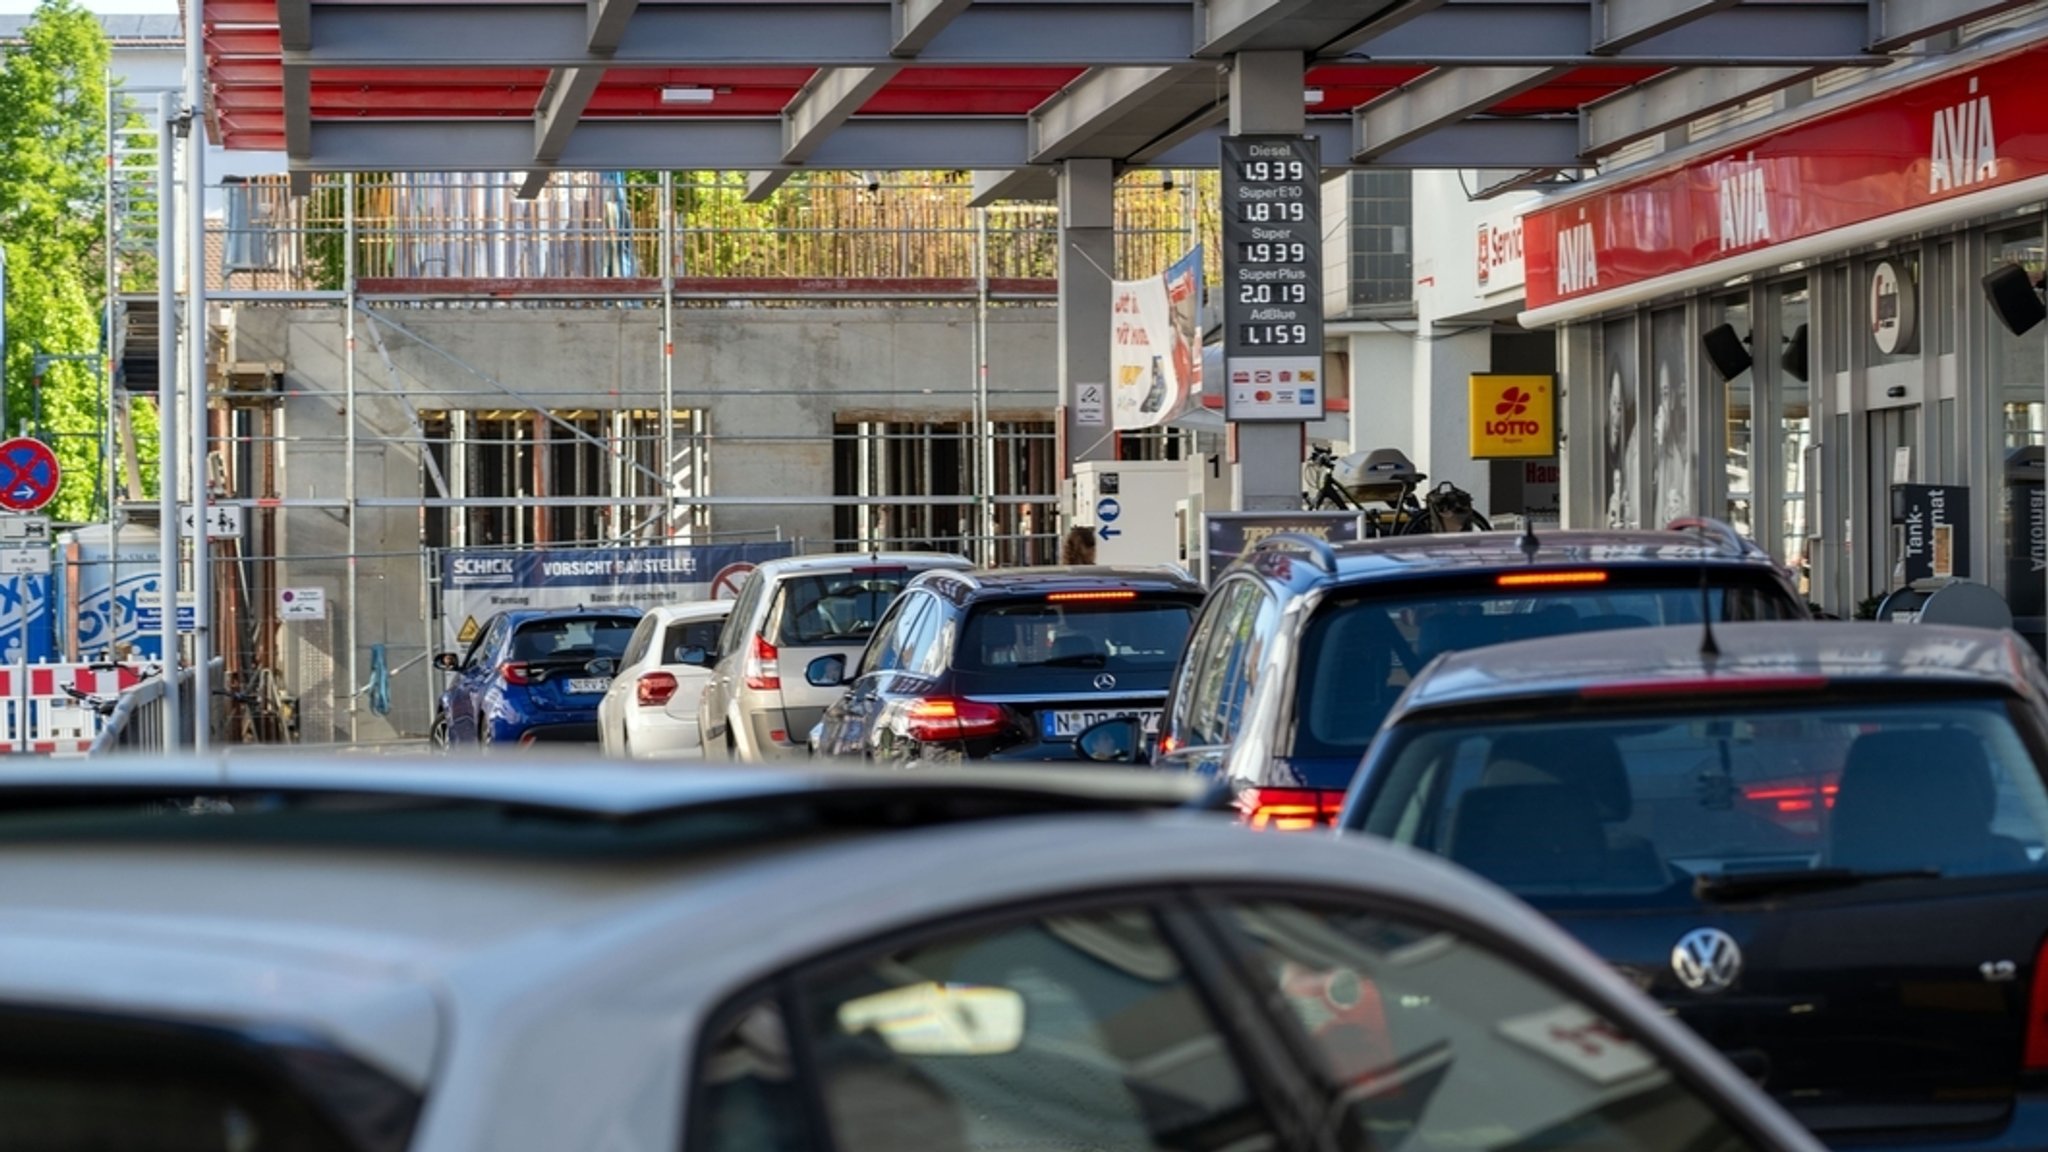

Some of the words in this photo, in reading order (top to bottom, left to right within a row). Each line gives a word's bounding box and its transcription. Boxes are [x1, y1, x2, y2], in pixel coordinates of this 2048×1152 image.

[1929, 76, 1998, 194] AVIA
[1249, 145, 1291, 157] Diesel
[1246, 161, 1303, 181] 1.939
[1239, 187, 1278, 199] Super
[1279, 186, 1303, 198] E10
[1720, 153, 1771, 251] AVIA
[1247, 202, 1304, 222] 1.879
[1252, 228, 1292, 240] Super
[1248, 243, 1304, 263] 1.939
[1557, 207, 1599, 296] AVIA
[1239, 269, 1277, 281] Super
[1278, 268, 1306, 280] Plus
[1240, 284, 1306, 304] 2.019
[1250, 308, 1297, 320] AdBlue
[1249, 325, 1306, 344] 1.159
[1485, 420, 1539, 436] LOTTO
[1208, 454, 1219, 478] 1
[1906, 504, 1923, 558] Tank-
[453, 558, 514, 575] SCHICK
[542, 559, 612, 577] VORSICHT
[614, 557, 697, 575] BAUSTELLE!
[1056, 713, 1071, 733] N
